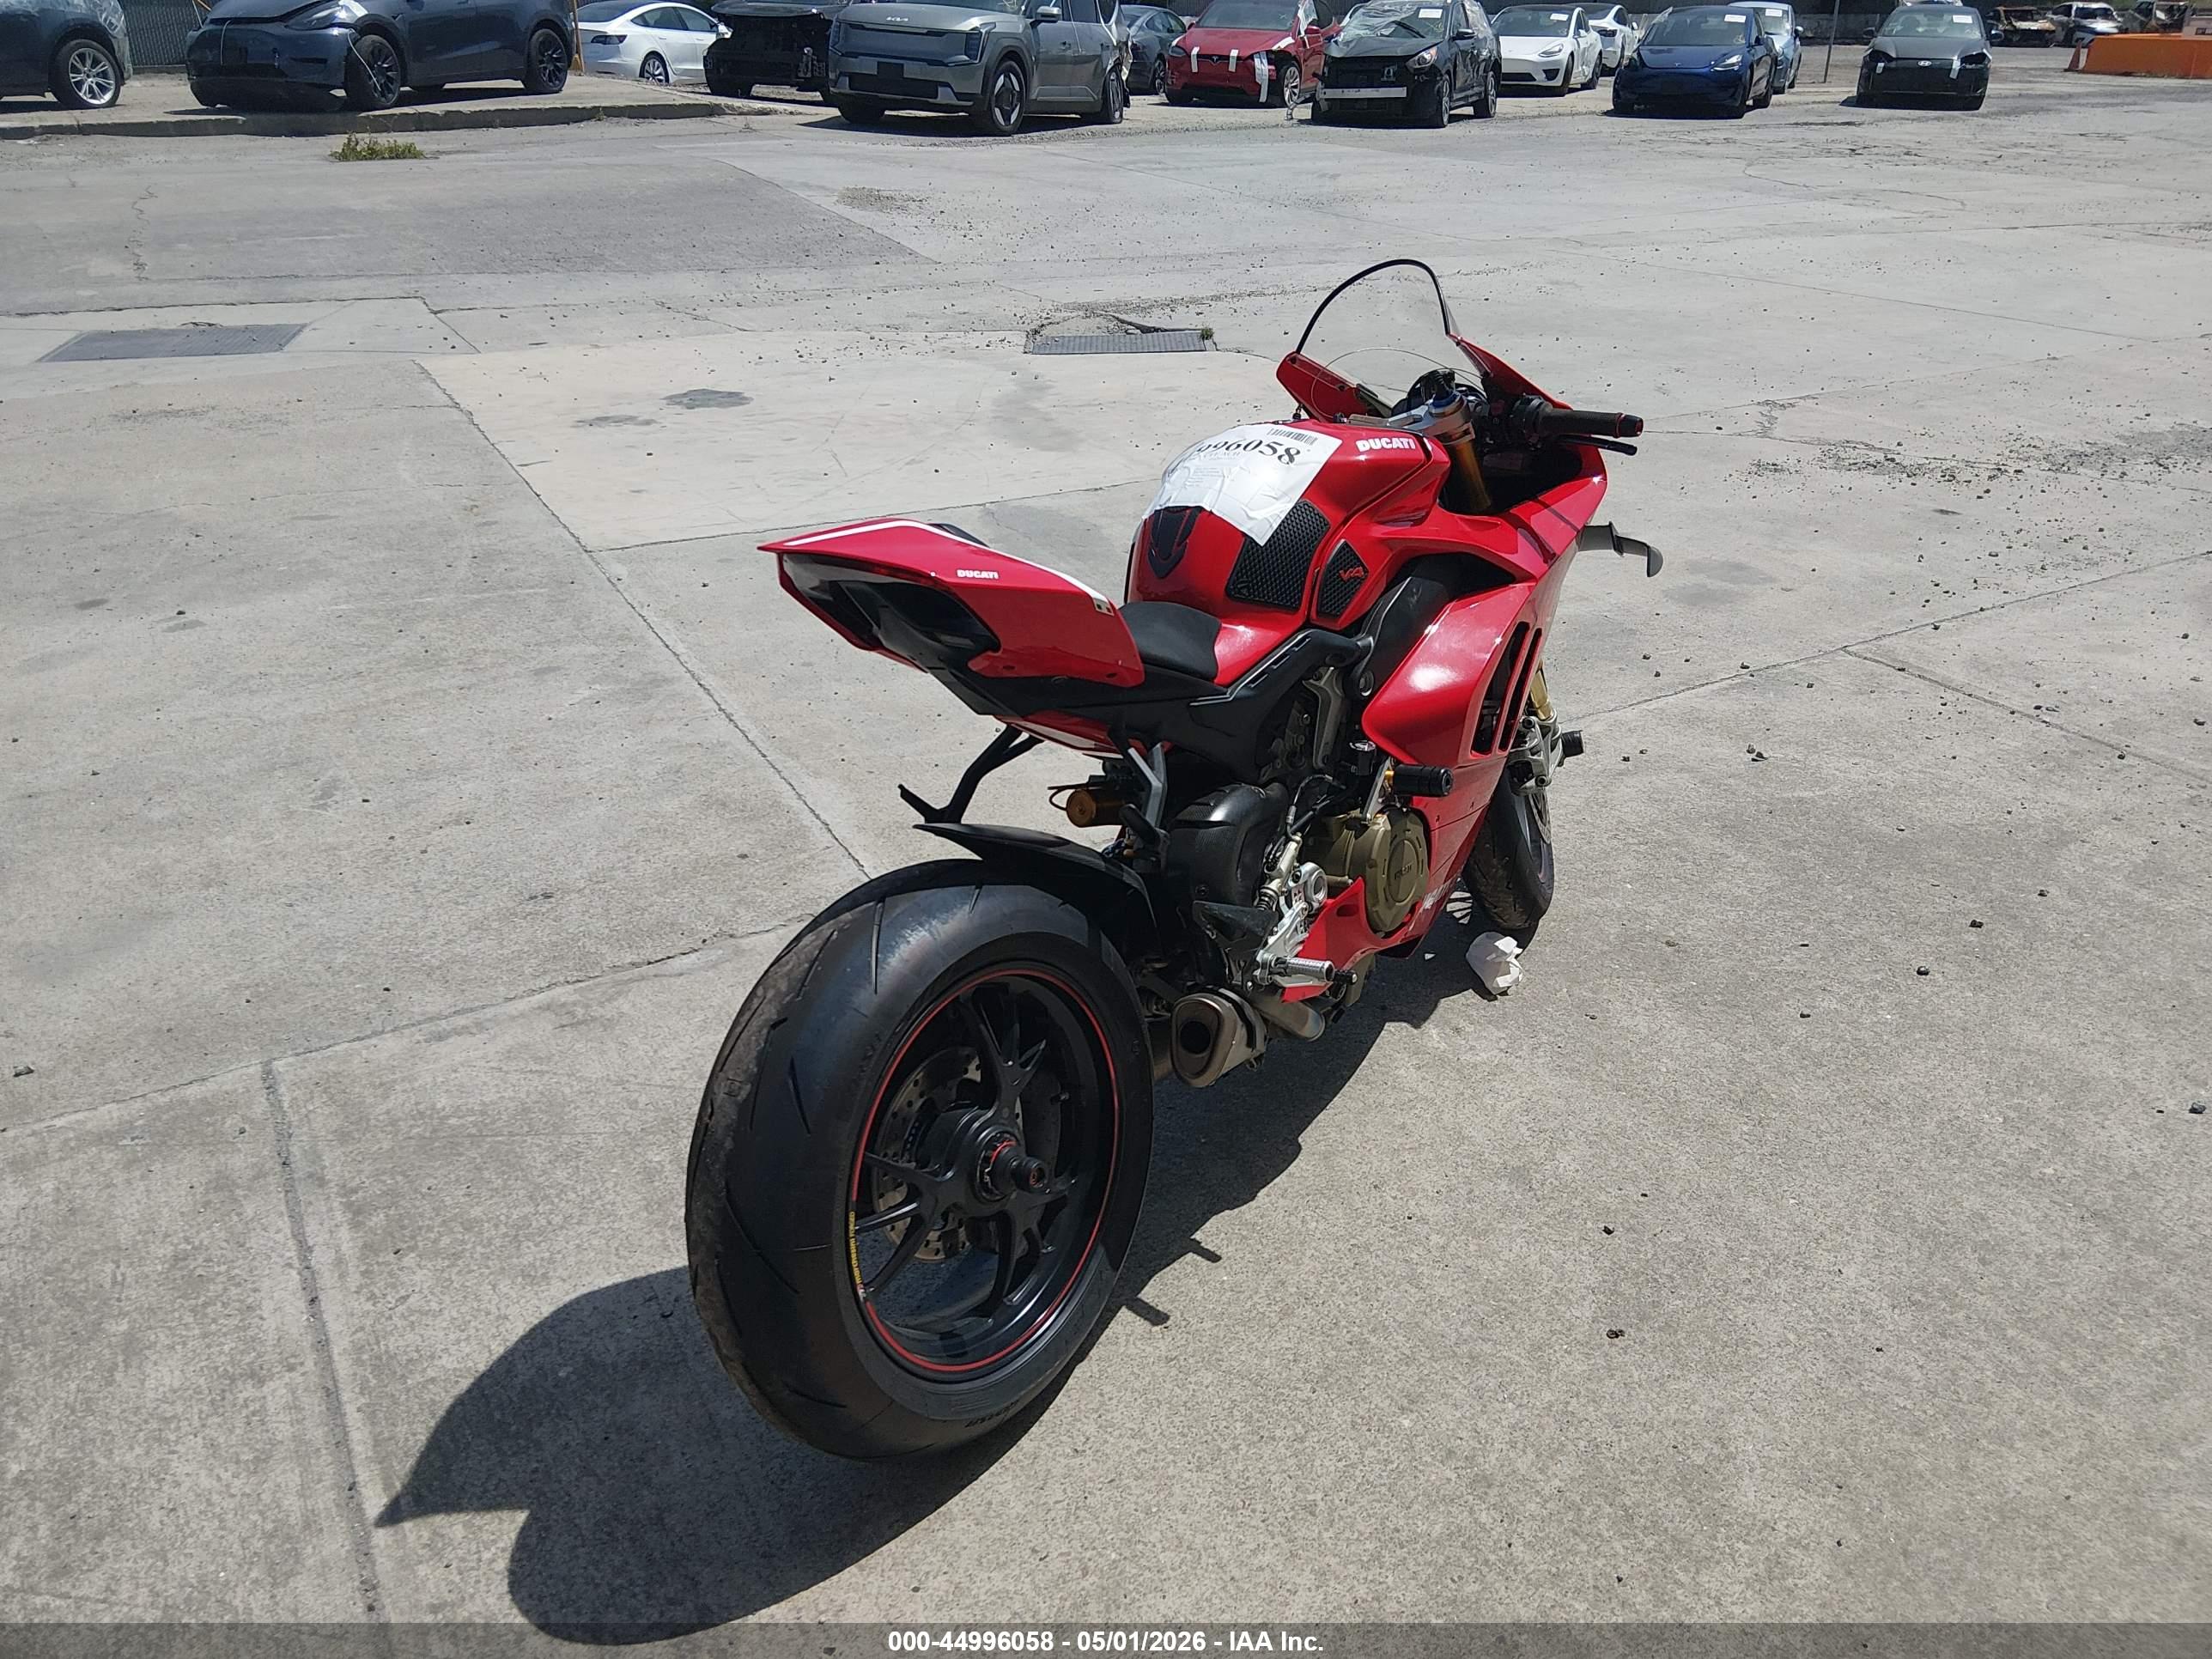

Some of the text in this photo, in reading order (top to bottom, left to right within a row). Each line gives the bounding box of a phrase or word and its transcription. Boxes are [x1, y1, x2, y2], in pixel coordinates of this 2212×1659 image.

[1356, 437, 1416, 453] DUCATI
[957, 569, 1000, 580] DUCATI
[1340, 566, 1364, 583] V4
